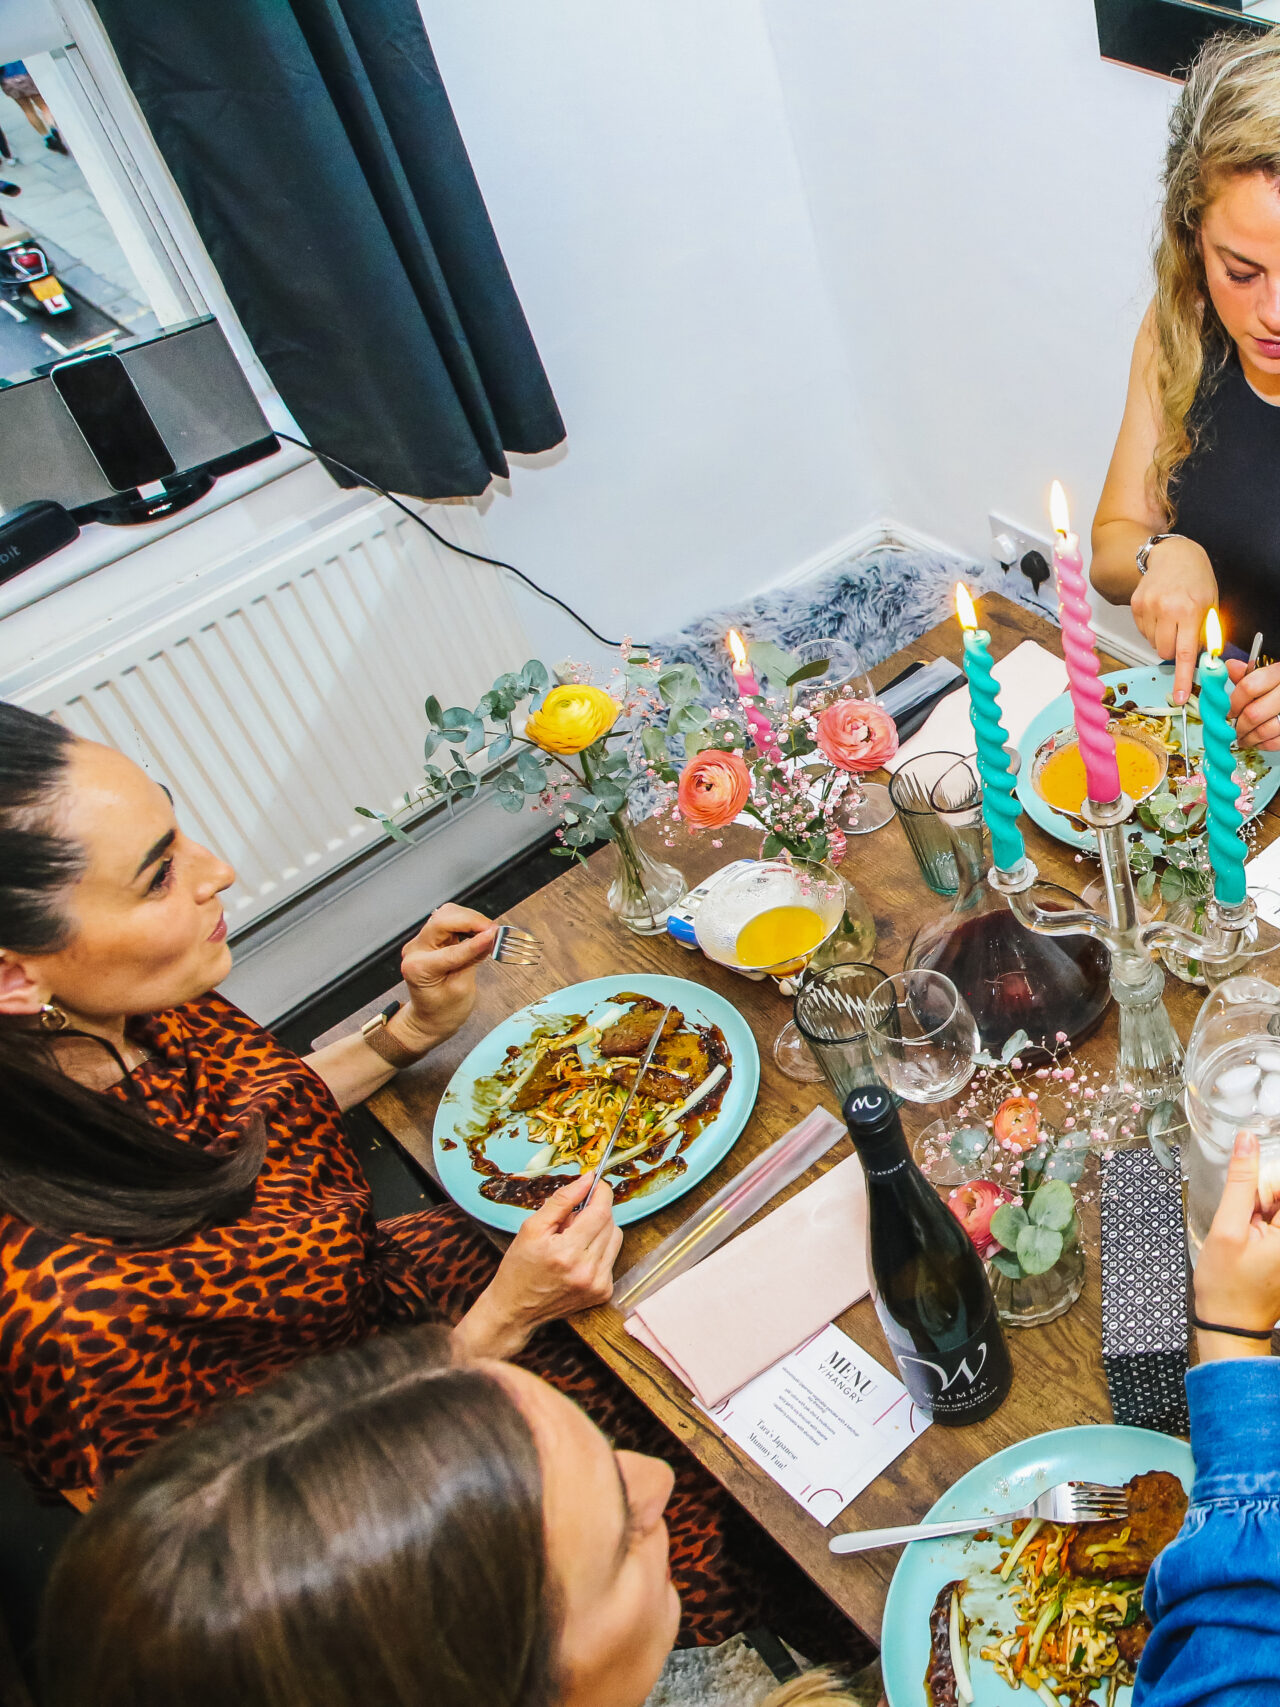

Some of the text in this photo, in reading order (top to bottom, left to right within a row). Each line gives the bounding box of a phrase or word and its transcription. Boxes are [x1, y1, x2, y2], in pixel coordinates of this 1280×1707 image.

[817, 1363, 863, 1405] Y/HANGRY
[825, 1350, 878, 1398] MENU
[923, 1382, 987, 1401] WAIMEA
[748, 1432, 788, 1471] Mummy Fun!
[756, 1419, 798, 1461] Tara's Japanese
